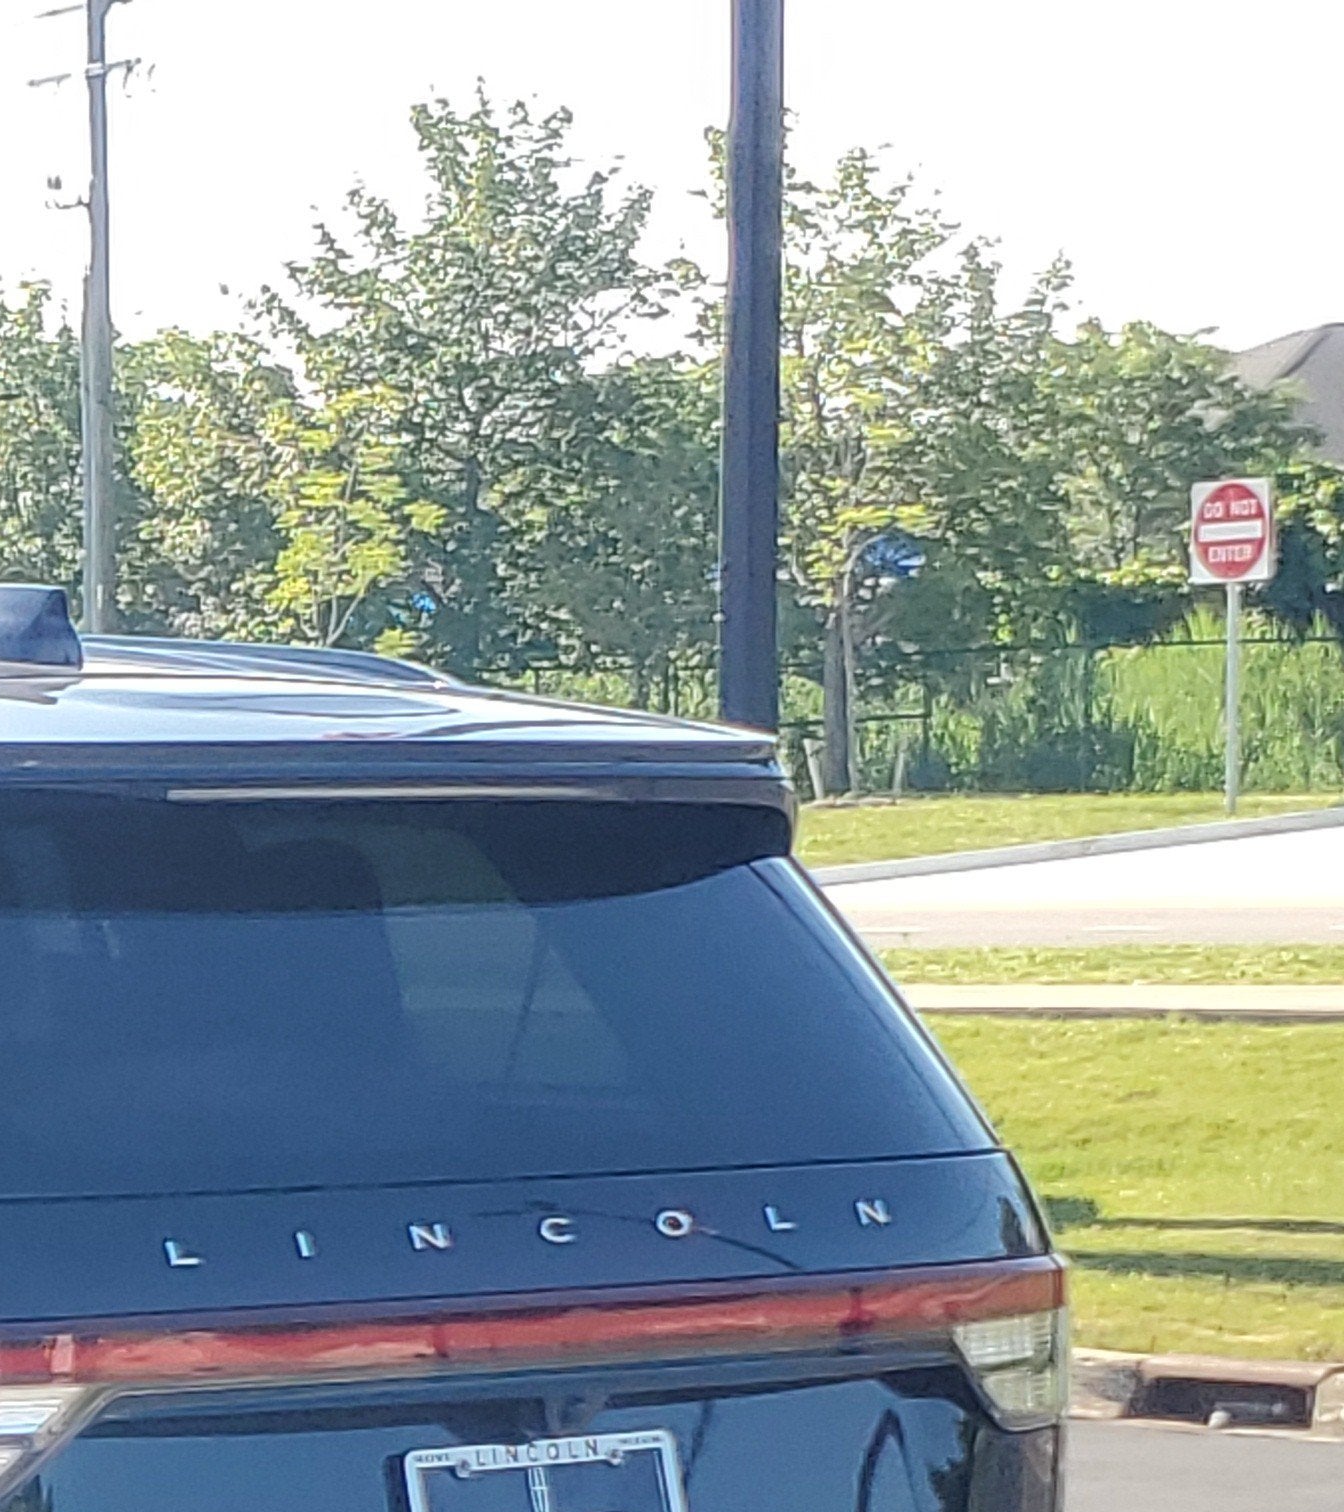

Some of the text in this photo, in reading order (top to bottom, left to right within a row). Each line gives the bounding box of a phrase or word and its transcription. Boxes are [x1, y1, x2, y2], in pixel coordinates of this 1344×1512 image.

[1203, 498, 1258, 519] DO NOT
[1207, 544, 1253, 563] ENTER
[164, 1198, 891, 1268] LINCOLN
[475, 1438, 598, 1467] LINCOLN
